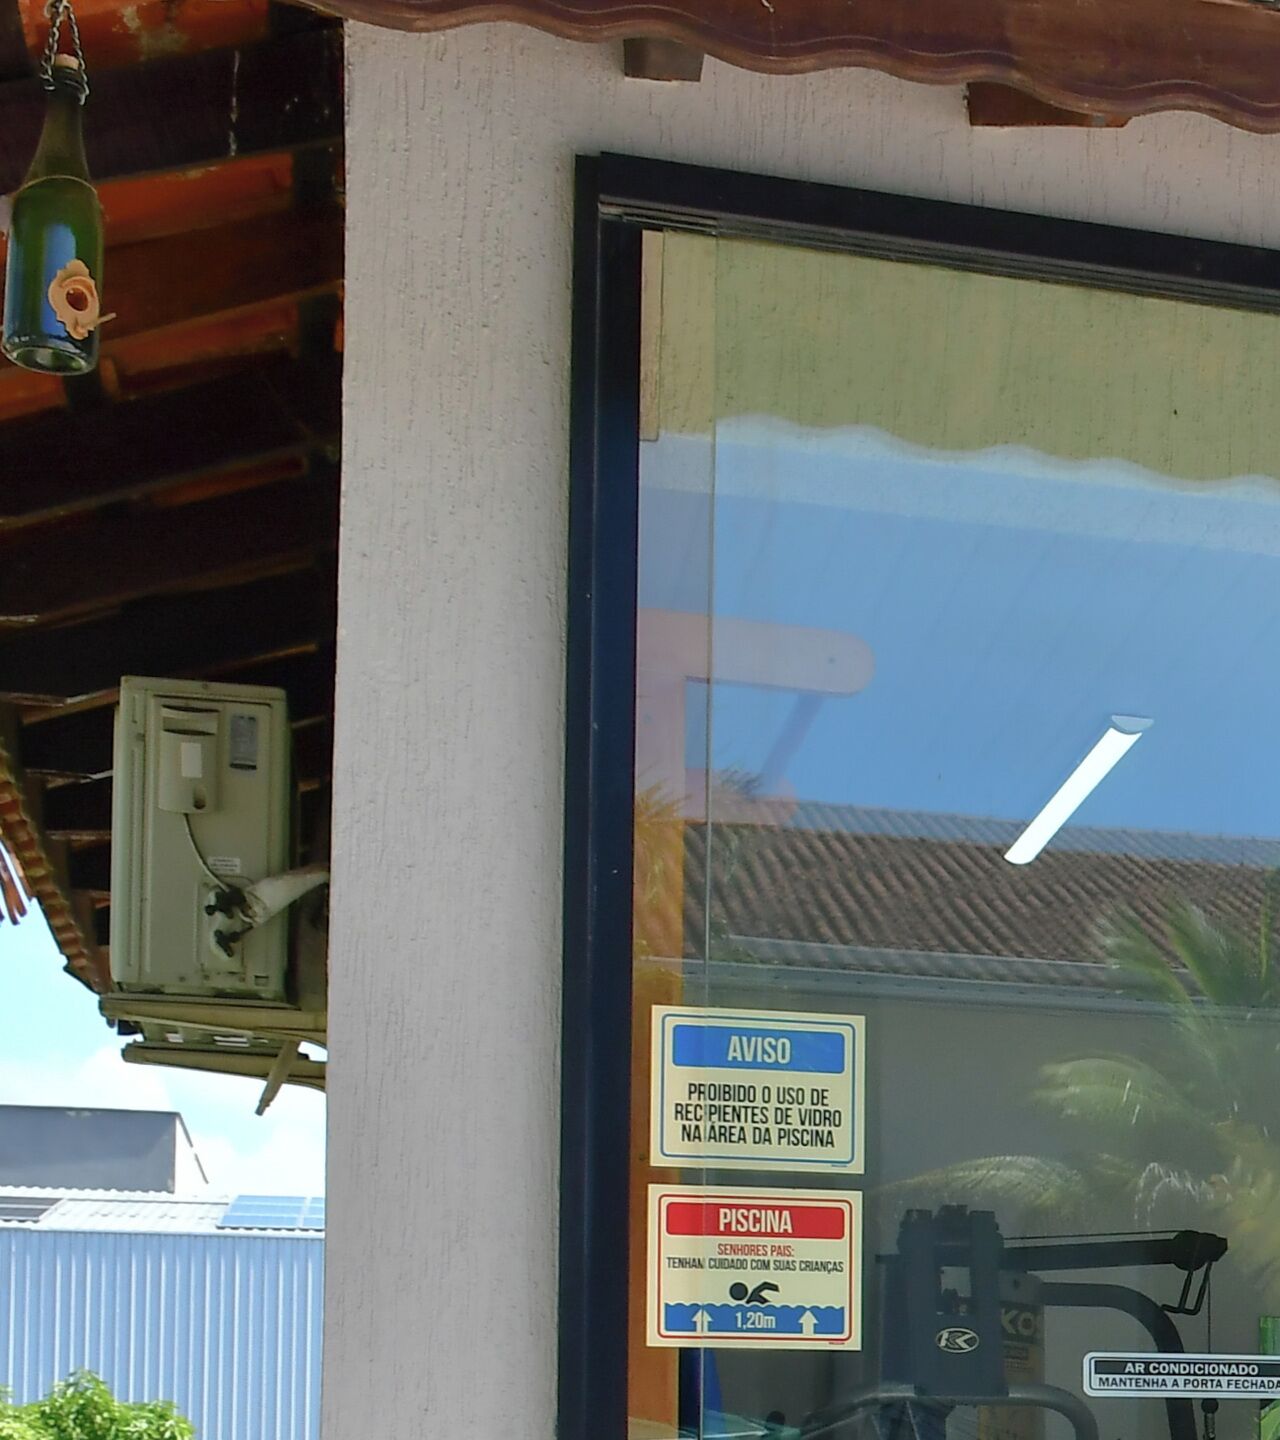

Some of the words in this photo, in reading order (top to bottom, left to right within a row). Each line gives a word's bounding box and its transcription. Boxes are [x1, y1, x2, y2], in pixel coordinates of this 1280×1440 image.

[727, 1035, 791, 1064] AVISO
[688, 1083, 756, 1103] PROIBIDO
[762, 1086, 771, 1104] O
[777, 1087, 805, 1105] USO
[811, 1088, 829, 1106] DE
[774, 1107, 793, 1126] DE
[798, 1109, 842, 1128] VIDRO
[681, 1124, 701, 1142] NA
[707, 1121, 747, 1144] ÁREA
[752, 1127, 772, 1145] DA
[778, 1128, 835, 1148] PISCINA
[719, 1208, 793, 1234] PISCINA
[717, 1243, 768, 1257] SENHORES
[770, 1245, 795, 1257] PAIS:
[708, 1258, 748, 1270] CUIDADO
[750, 1259, 771, 1271] COM
[773, 1260, 797, 1272] SUAS
[799, 1261, 844, 1274] CRIANÇAS
[735, 1312, 776, 1329] 1,20m
[1124, 1362, 1145, 1374] AR
[1149, 1363, 1259, 1376] CONDICIONADO
[1098, 1377, 1167, 1388] MANTENHA
[1171, 1378, 1180, 1388] A
[1183, 1379, 1223, 1389] PORTA
